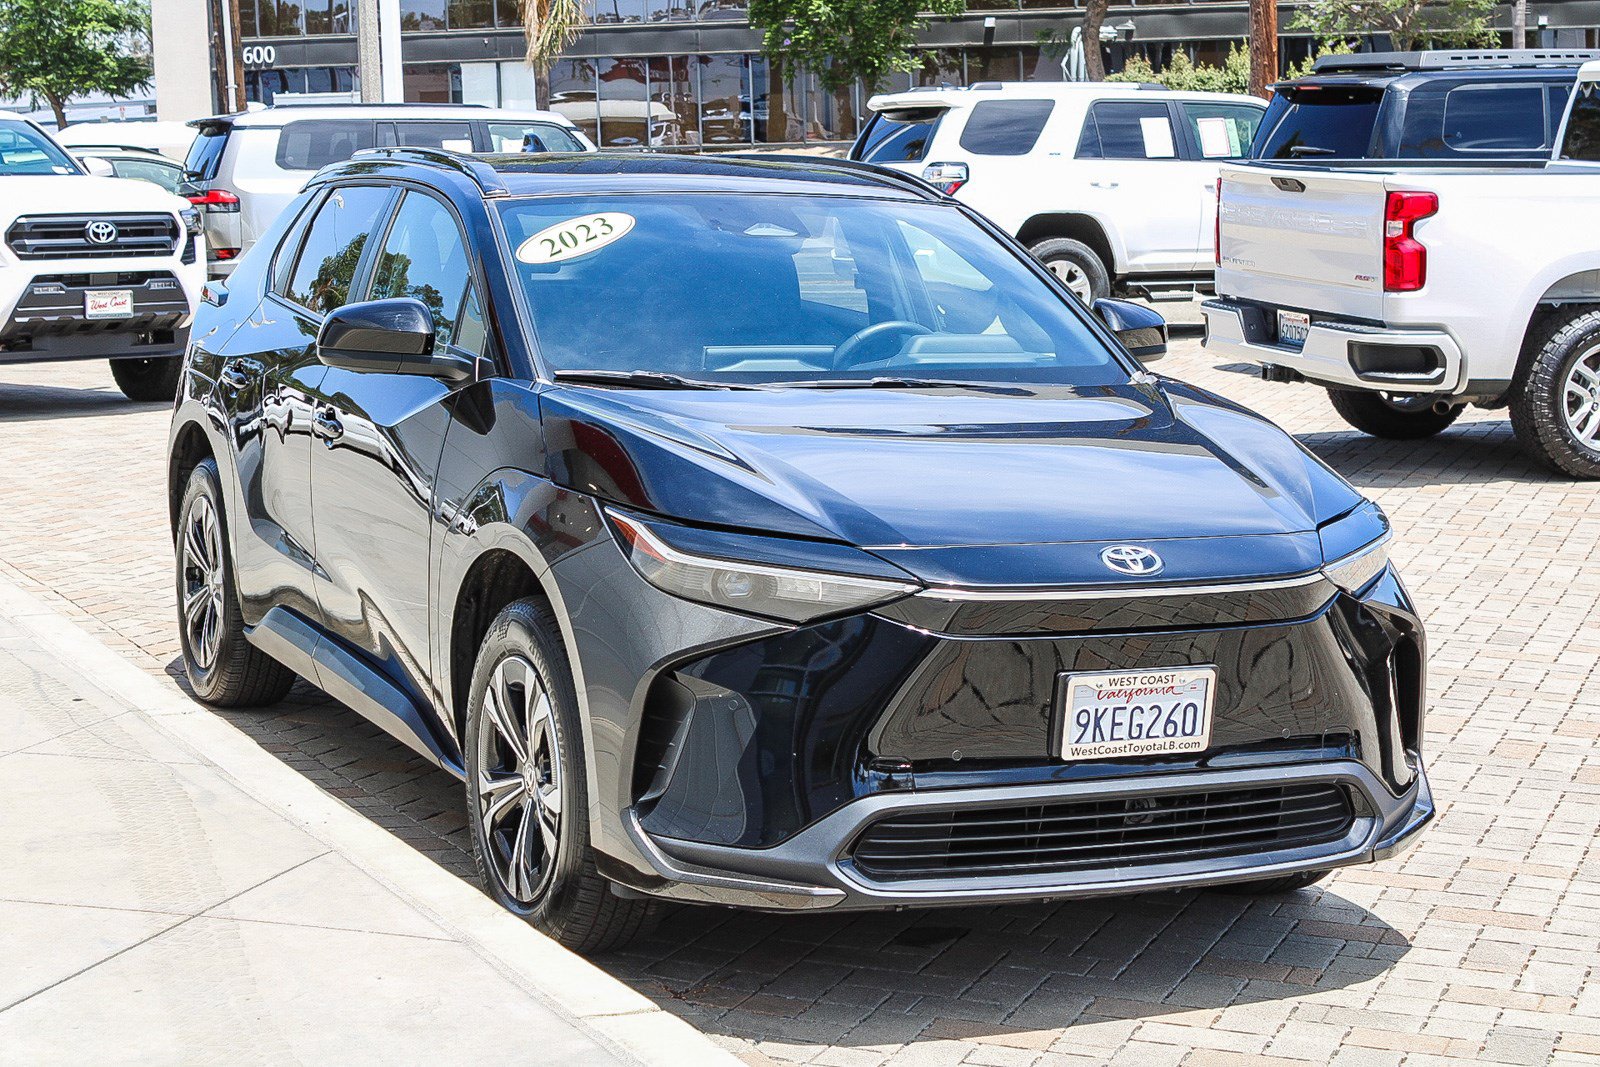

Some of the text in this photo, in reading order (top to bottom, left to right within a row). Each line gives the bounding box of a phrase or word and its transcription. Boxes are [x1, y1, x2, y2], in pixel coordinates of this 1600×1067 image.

[243, 46, 275, 64] 600
[540, 217, 614, 257] 2023
[90, 296, 127, 310] West Coast
[1108, 674, 1177, 687] WEST COAST
[1097, 686, 1184, 704] California
[1075, 702, 1198, 744] 9KEG260
[1070, 740, 1201, 757] WestCoastToyotaLB.com
